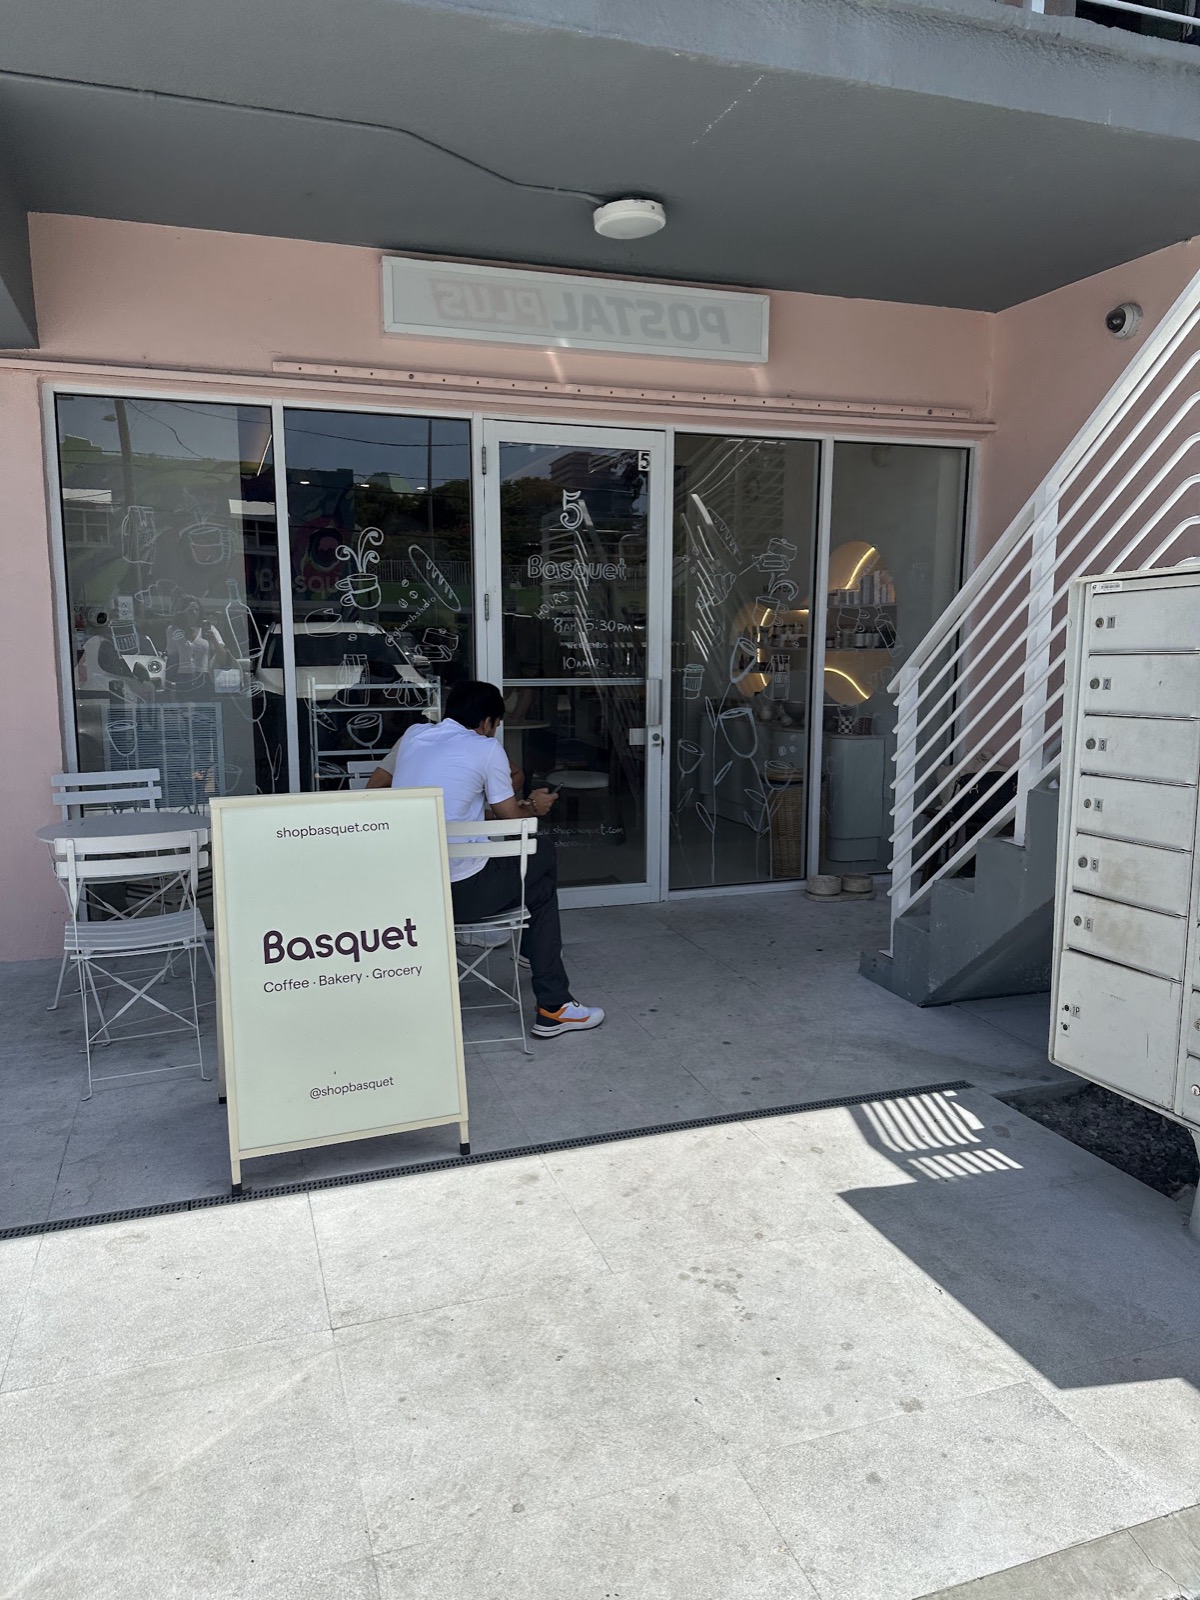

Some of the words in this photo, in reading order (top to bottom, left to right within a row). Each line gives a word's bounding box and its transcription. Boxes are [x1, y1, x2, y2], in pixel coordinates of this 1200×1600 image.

[641, 453, 650, 469] 5
[559, 489, 584, 530] 5
[527, 555, 627, 587] Basquet
[533, 591, 570, 620] HOURS
[565, 642, 609, 650] WEEENDS
[276, 821, 390, 839] shopbasquet.com
[263, 918, 418, 965] Basquet
[263, 976, 310, 993] Coffee
[318, 970, 364, 989] Bakery
[371, 964, 423, 984] Grocery
[309, 1076, 394, 1099] @shopbasquet
